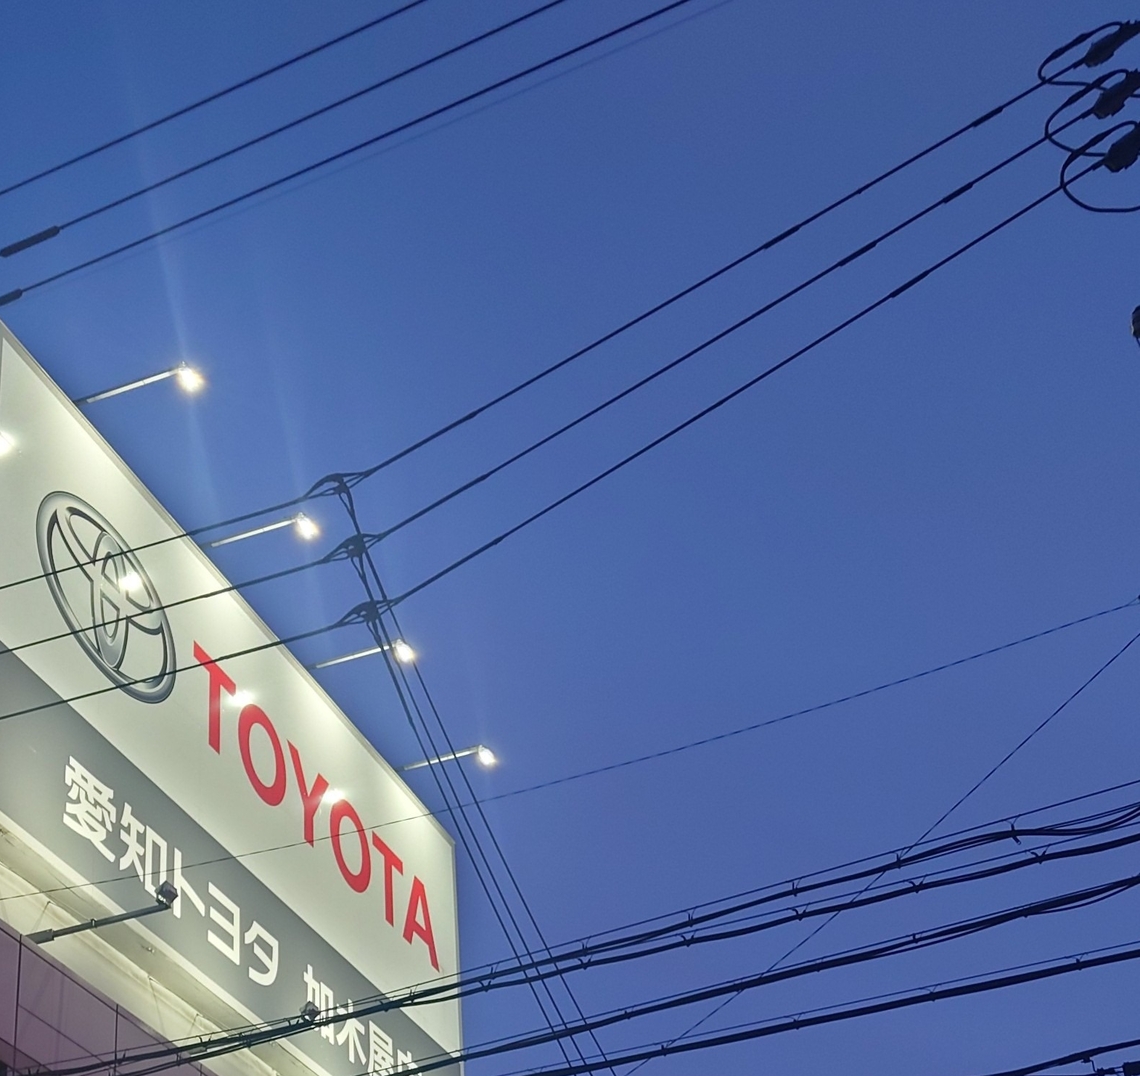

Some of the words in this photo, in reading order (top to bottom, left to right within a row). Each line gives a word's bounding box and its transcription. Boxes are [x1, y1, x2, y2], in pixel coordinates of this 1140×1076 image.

[63, 755, 279, 986] 愛知トヨタ
[193, 640, 440, 972] TOYOTA
